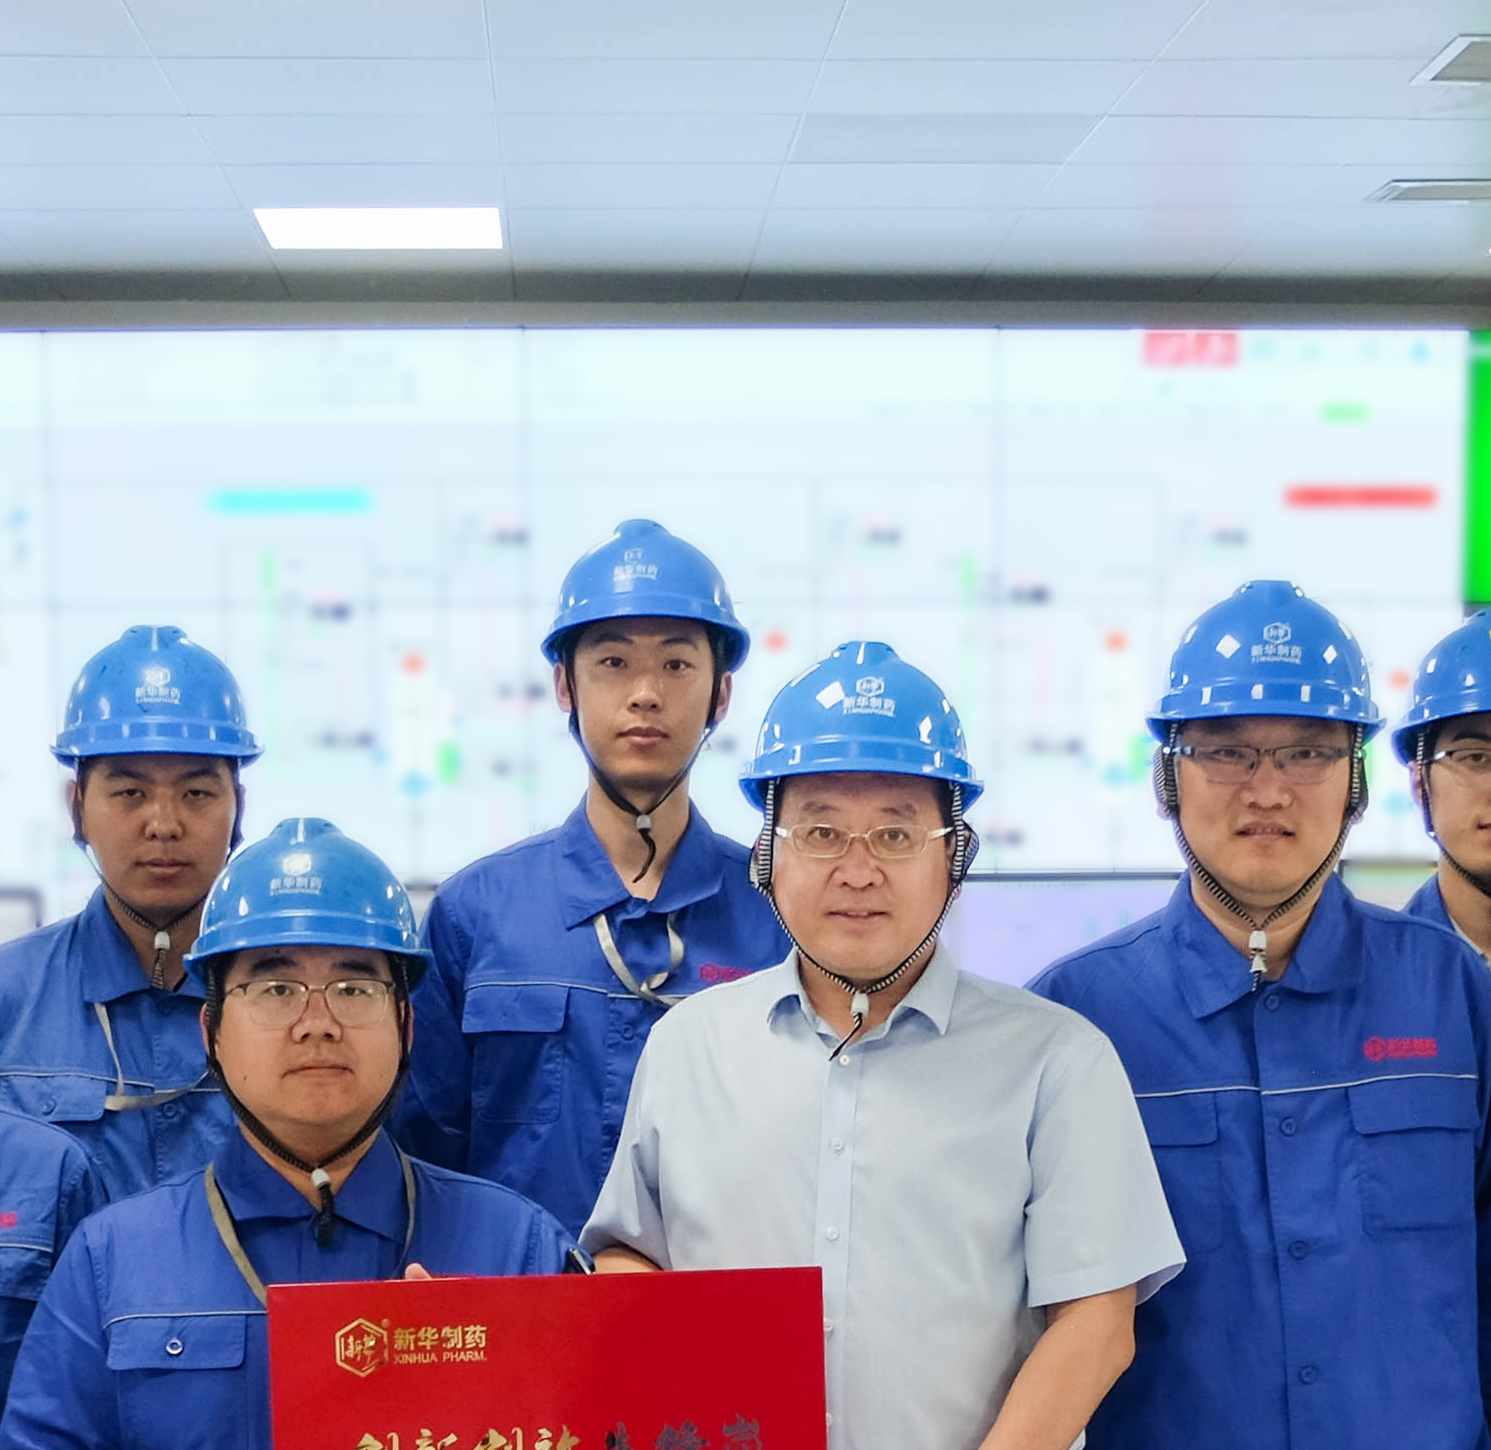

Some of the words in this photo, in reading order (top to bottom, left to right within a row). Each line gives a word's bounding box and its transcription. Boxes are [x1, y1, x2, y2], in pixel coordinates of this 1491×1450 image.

[1251, 643, 1302, 658] 新华制药
[842, 696, 895, 711] 新华制药
[394, 1325, 487, 1350] 新华制药
[394, 1353, 438, 1364] XINHUA
[442, 1350, 488, 1363] PHARM.
